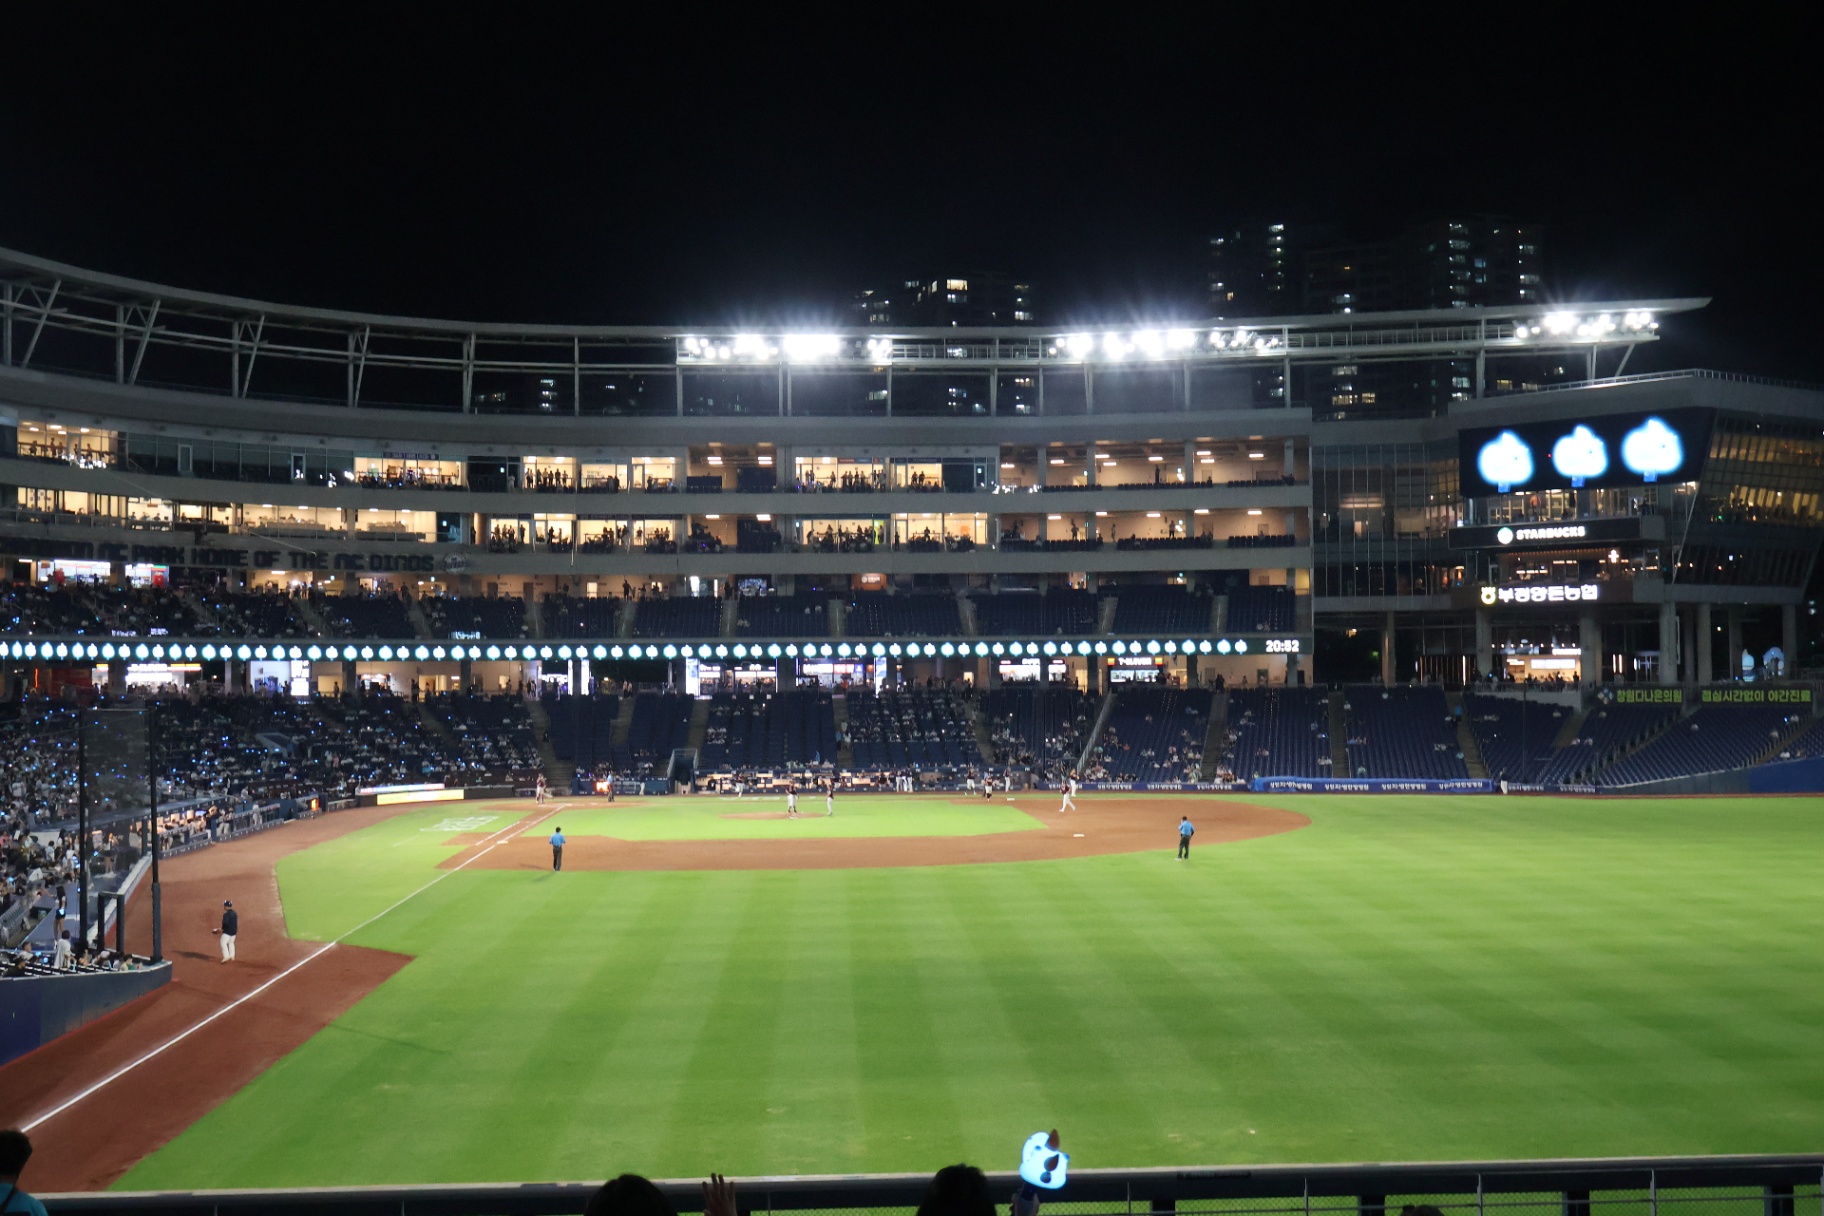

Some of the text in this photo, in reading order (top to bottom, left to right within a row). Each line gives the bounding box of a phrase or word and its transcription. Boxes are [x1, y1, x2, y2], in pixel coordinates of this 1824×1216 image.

[1516, 526, 1585, 540] STARBUCKS
[191, 548, 249, 566] HOME
[254, 550, 281, 567] OF
[288, 551, 328, 570] THE
[369, 553, 434, 572] DINOS
[1498, 584, 1598, 603] 부경양돈농협
[1266, 640, 1299, 652] 20:52
[1617, 689, 1682, 702] 창원다나은의원
